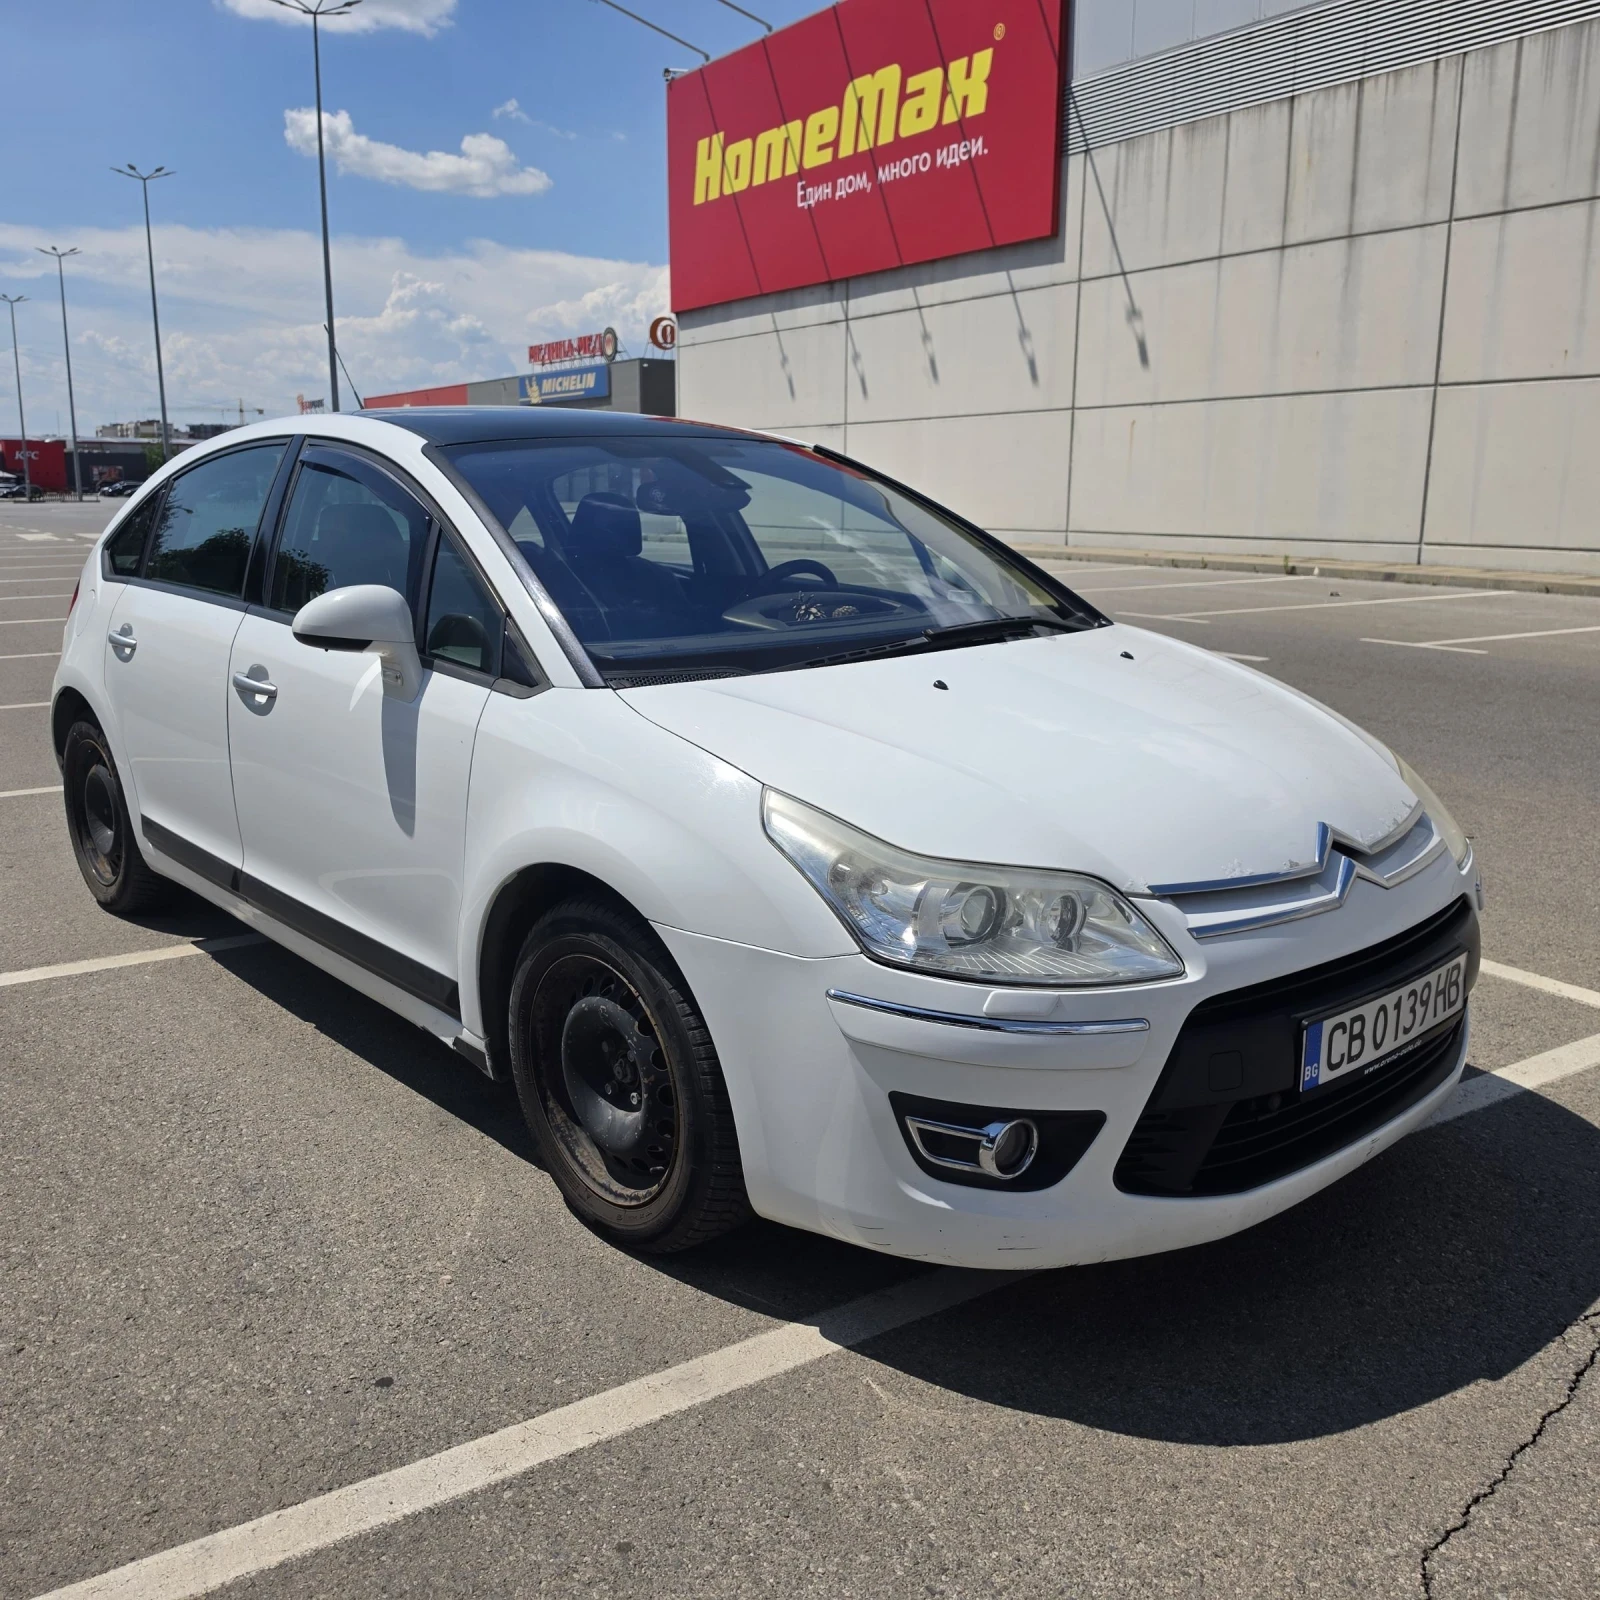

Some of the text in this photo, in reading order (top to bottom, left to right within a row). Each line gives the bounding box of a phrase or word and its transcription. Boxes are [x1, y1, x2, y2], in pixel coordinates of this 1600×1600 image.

[692, 47, 994, 206] HomeMax
[796, 136, 989, 209] Един дом, много идеи.
[541, 372, 596, 394] MICHELIN
[14, 450, 39, 461] KFC
[1304, 1063, 1319, 1081] BG
